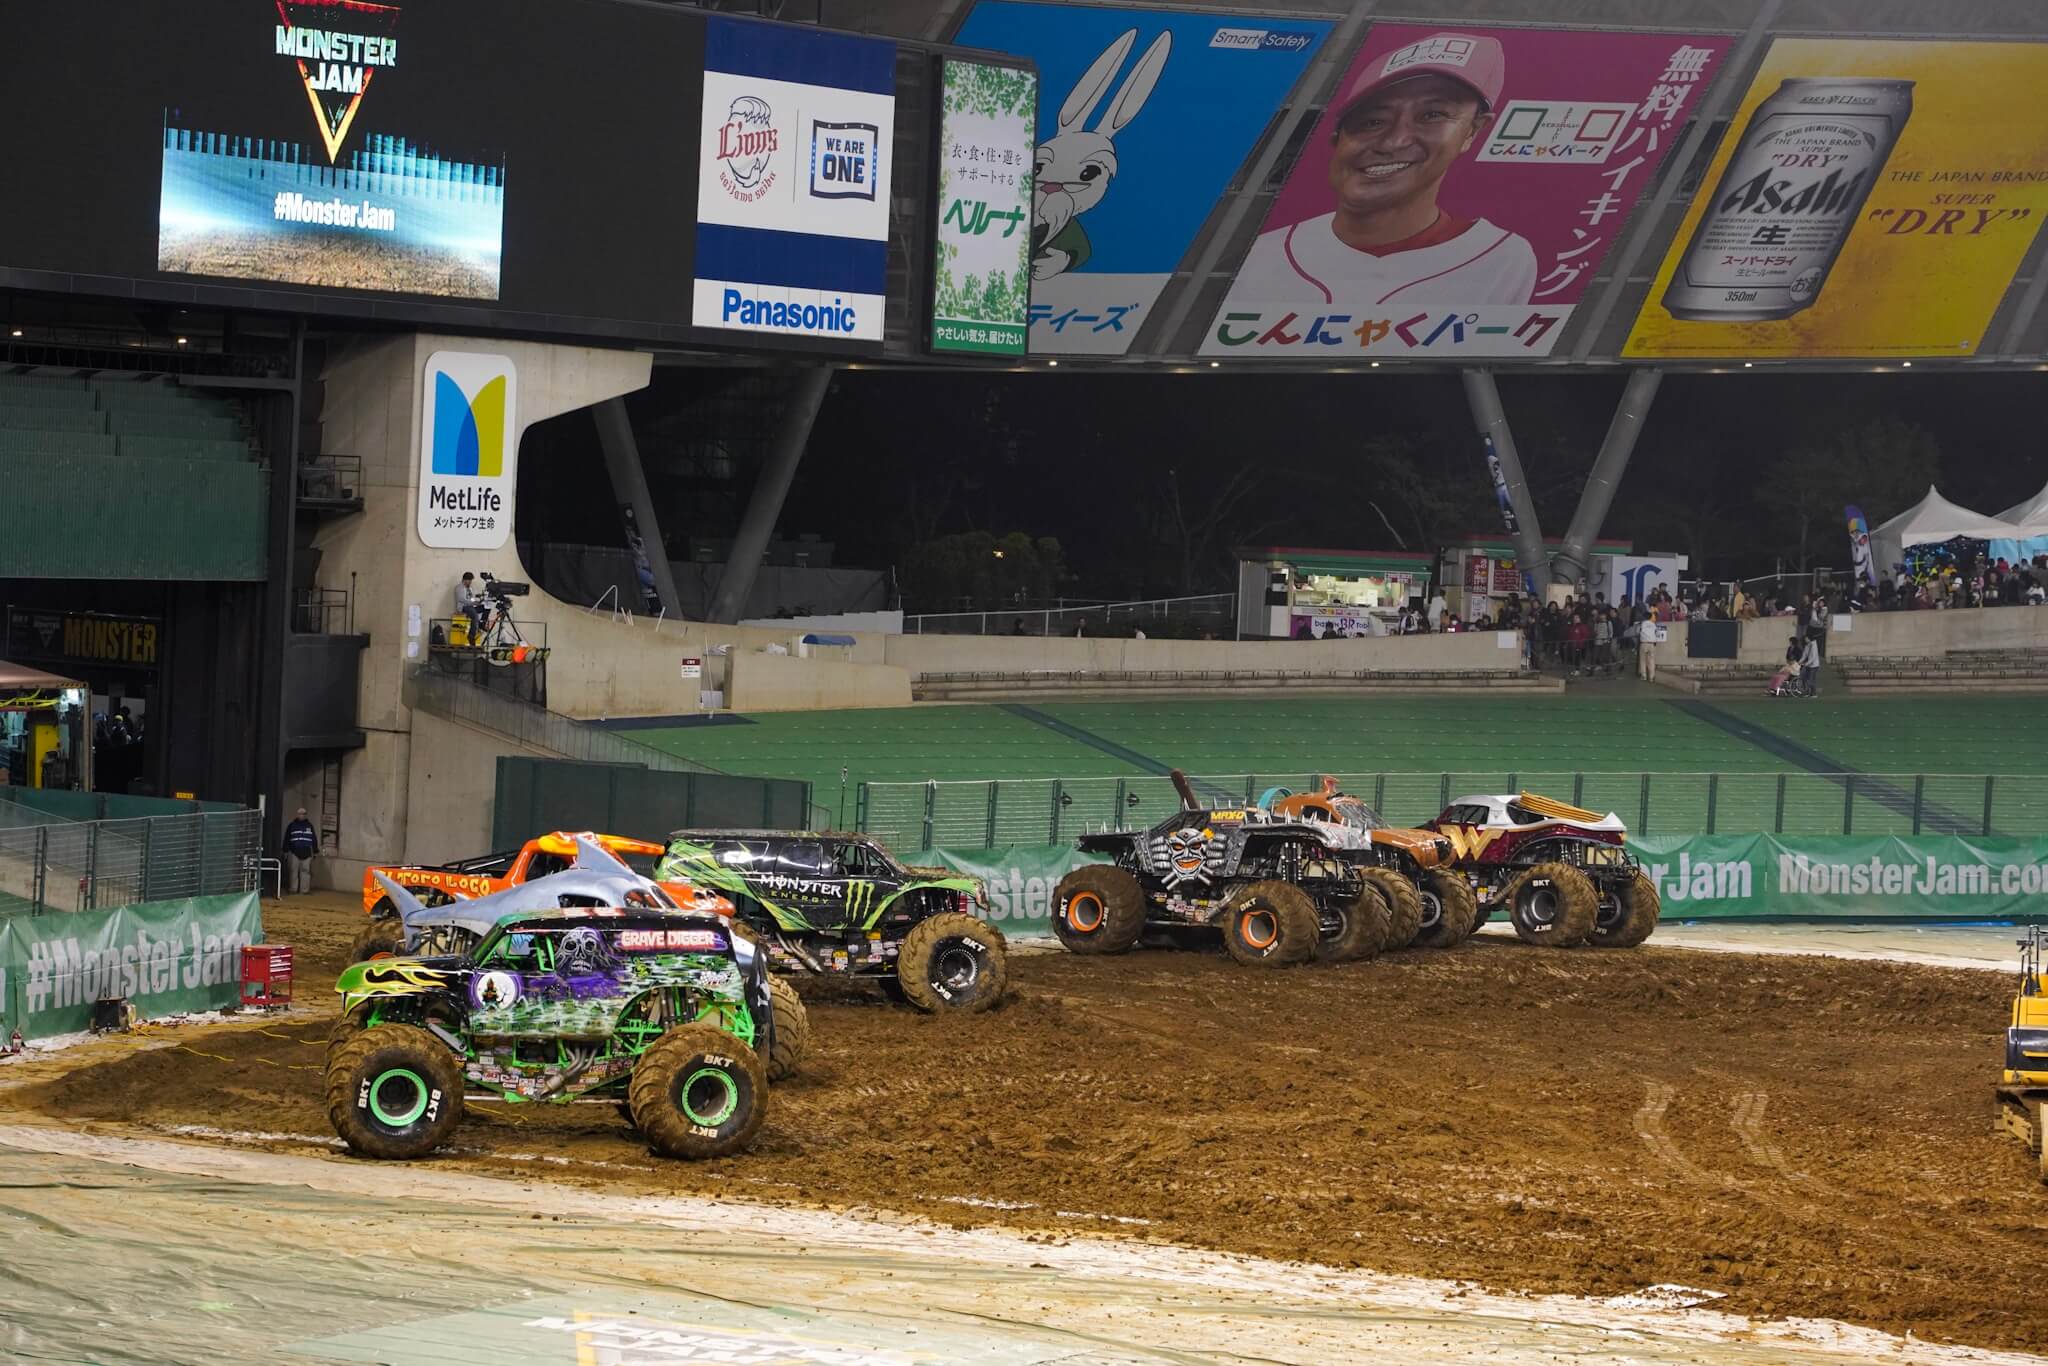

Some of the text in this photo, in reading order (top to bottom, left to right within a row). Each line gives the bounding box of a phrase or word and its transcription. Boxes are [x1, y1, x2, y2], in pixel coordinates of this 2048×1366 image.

[275, 24, 397, 67] MONSTER
[1215, 31, 1258, 45] Smart
[1266, 33, 1311, 51] Safety
[309, 62, 363, 94] JAM
[717, 121, 779, 161] Lions
[826, 137, 865, 154] WE ARE
[822, 154, 865, 184] ONE
[958, 166, 1014, 186] サポートする
[1536, 44, 1716, 297] 無料バイキング
[1889, 171, 2048, 182] THE JAPAN BRAND
[1720, 166, 1869, 216] Asahi
[1930, 193, 1997, 205] SUPER
[274, 191, 395, 232] #MonsterJam
[943, 199, 1026, 238] ベルーナ
[1750, 225, 1792, 245] 生
[1721, 255, 1798, 266] スーパードライ
[1725, 291, 1758, 302] 350ml
[722, 288, 856, 332] Panasonic
[1216, 312, 1560, 348] こんにゃくパーク
[430, 485, 501, 512] MetLife
[433, 516, 496, 530] メットライフ生命
[63, 617, 157, 664] MONSTER
[760, 874, 842, 898] MONSTER
[1532, 879, 1550, 887] BKT
[770, 890, 829, 904] ENERGY
[622, 931, 715, 946] GRAVE DIGGER
[962, 937, 986, 952] BKT
[26, 921, 251, 1013] #MonsterJam
[931, 982, 952, 1000] BKT
[704, 1054, 734, 1067] BKT
[358, 1077, 371, 1108] BKT
[426, 1088, 442, 1122] BKT
[688, 1125, 718, 1138] BKT
